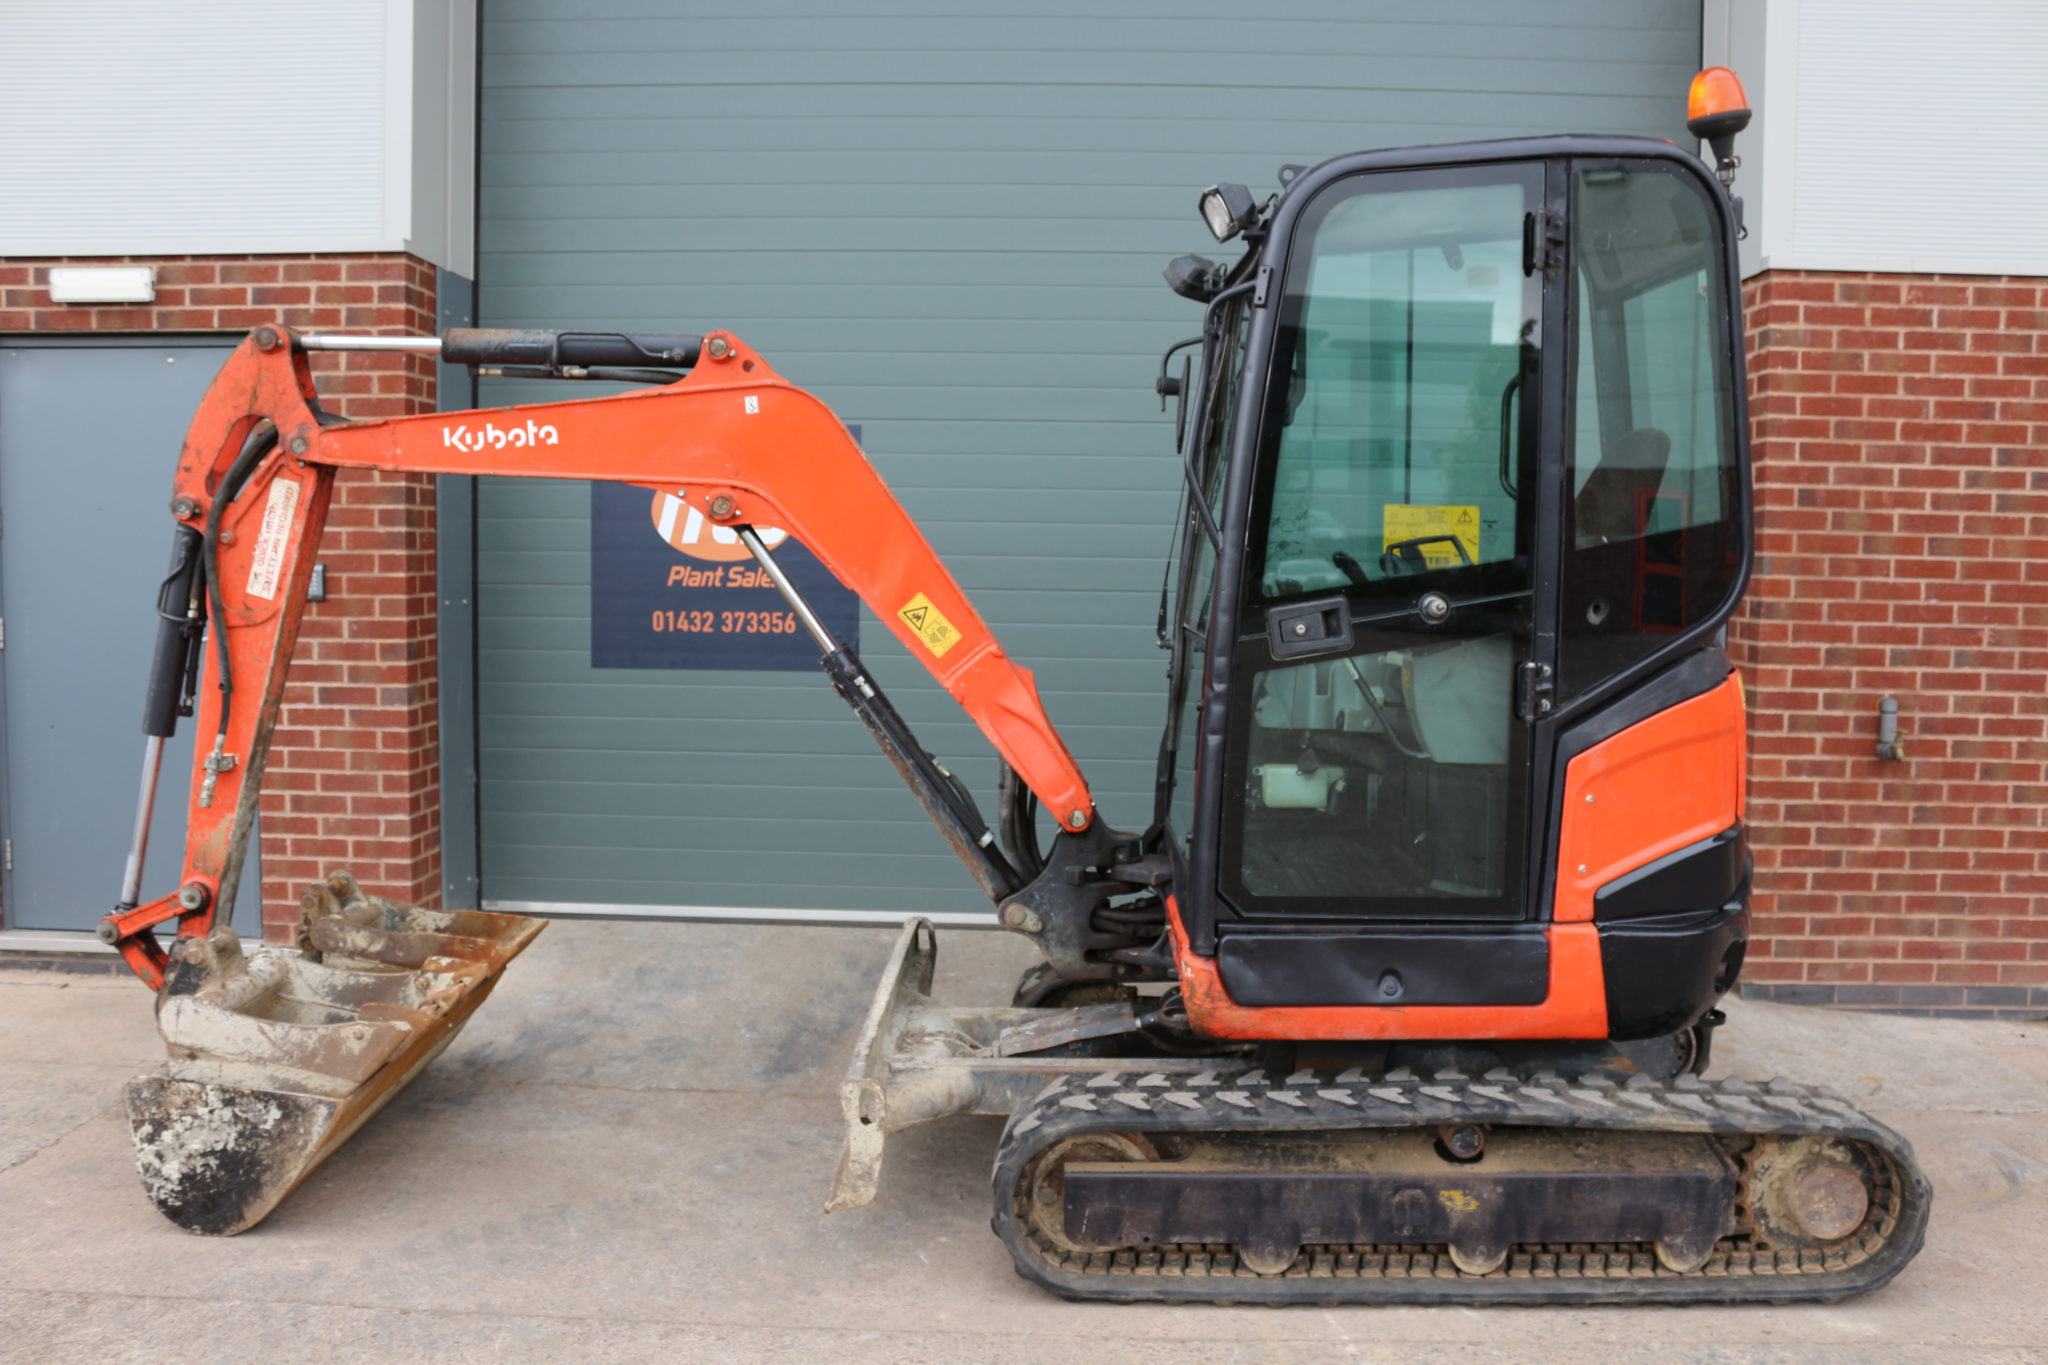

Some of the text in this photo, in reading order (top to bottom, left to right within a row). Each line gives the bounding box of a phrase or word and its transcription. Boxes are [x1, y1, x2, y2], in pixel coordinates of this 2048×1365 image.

[443, 419, 559, 452] Kubota
[667, 565, 778, 588] Plant Sale
[652, 610, 797, 634] 01432 373356
